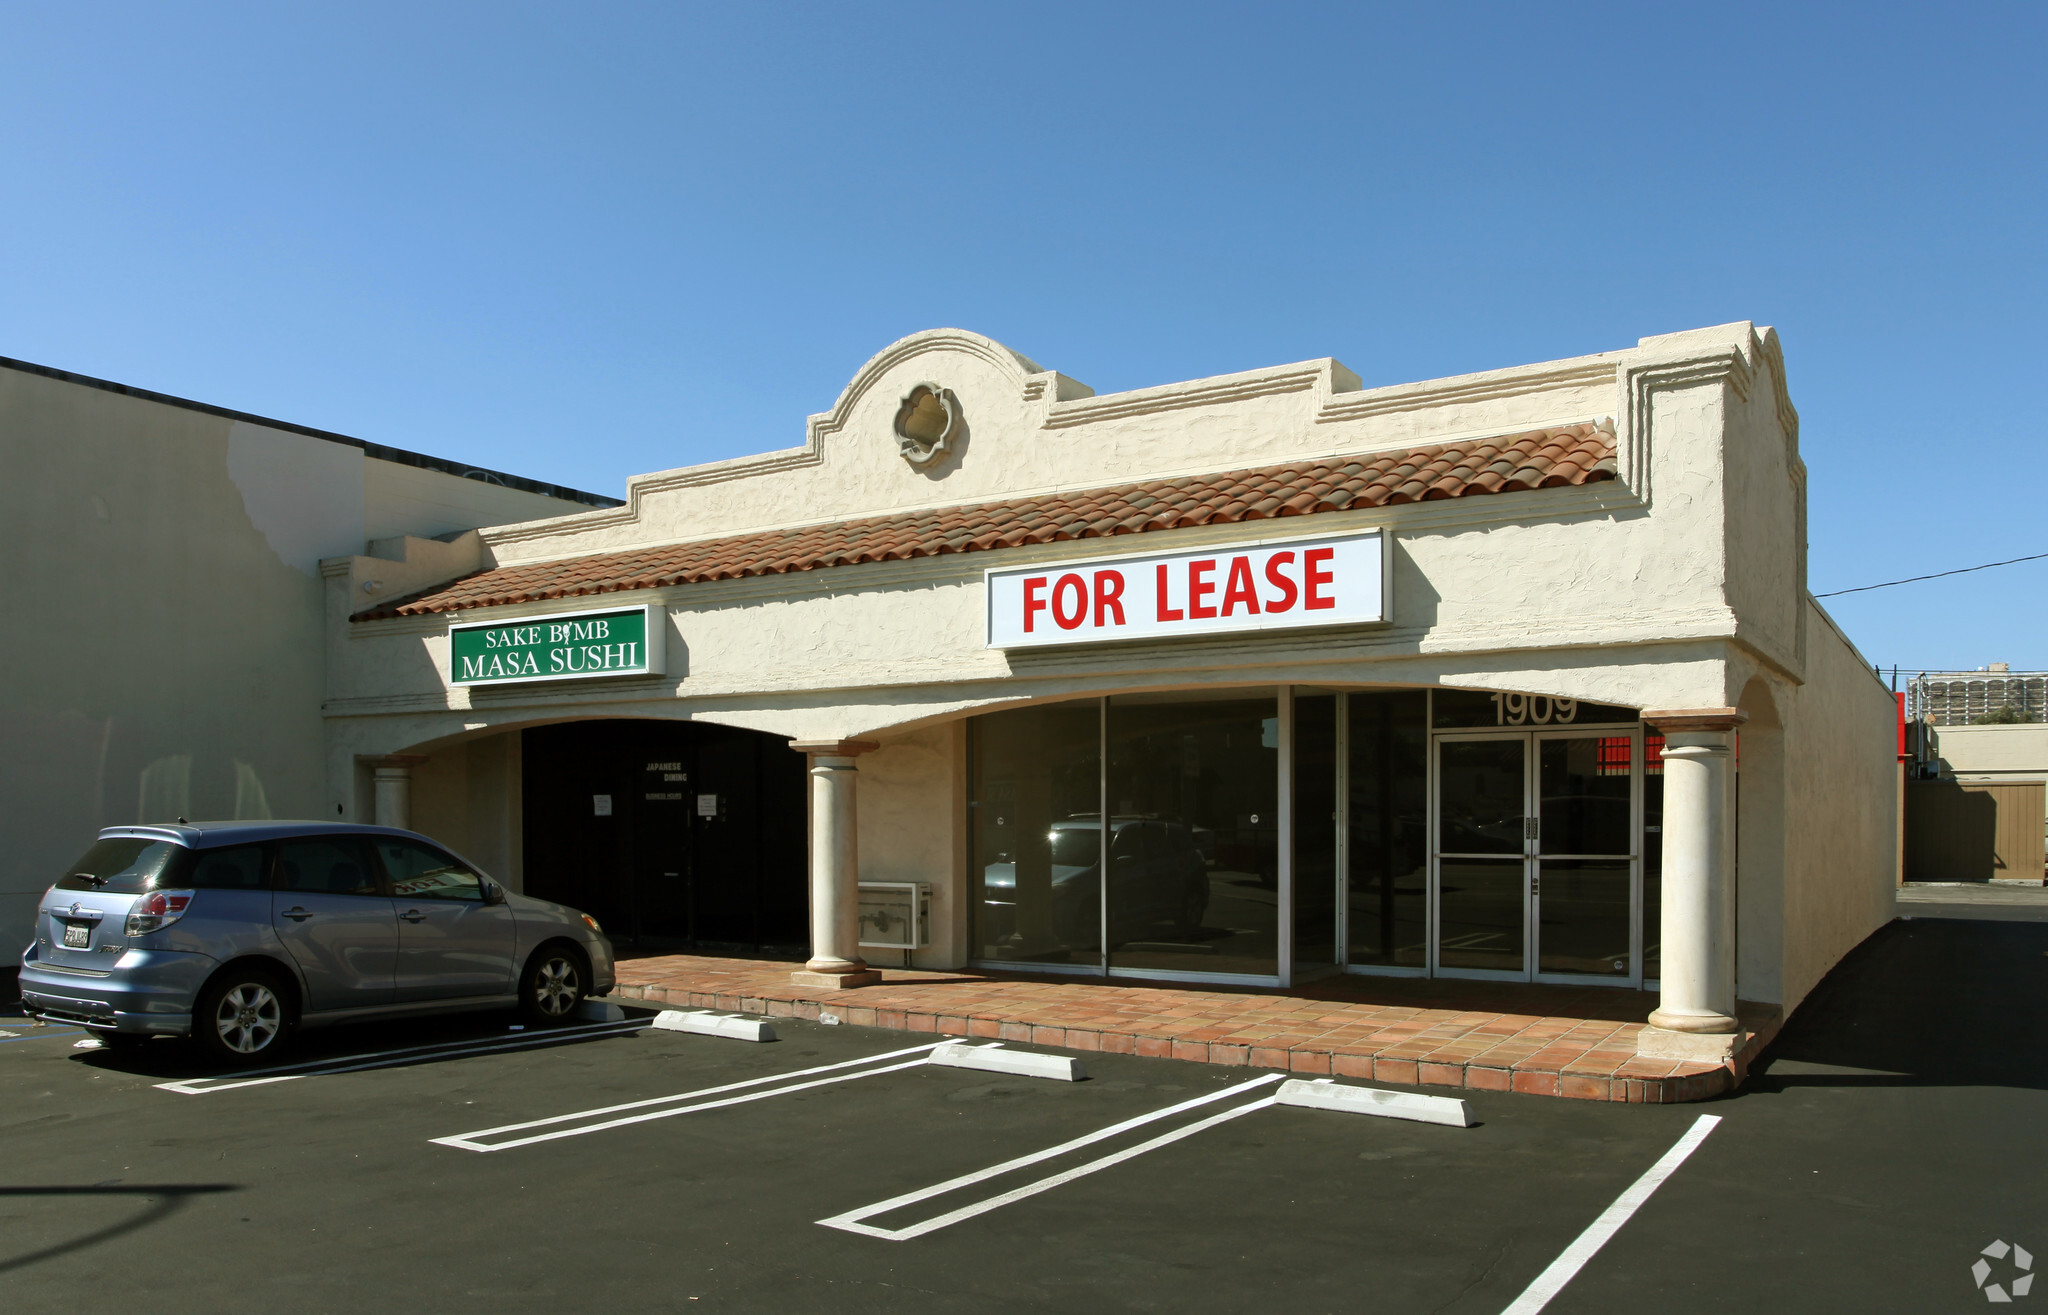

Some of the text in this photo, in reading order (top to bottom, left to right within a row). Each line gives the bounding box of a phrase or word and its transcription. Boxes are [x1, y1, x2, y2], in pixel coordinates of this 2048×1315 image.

[1023, 547, 1336, 633] FOR LEASE
[485, 626, 542, 648] SAKE
[461, 641, 639, 679] MASA SUSHI
[1490, 691, 1578, 726] 1909
[646, 762, 682, 771] JAPANESE
[664, 773, 688, 782] DINING
